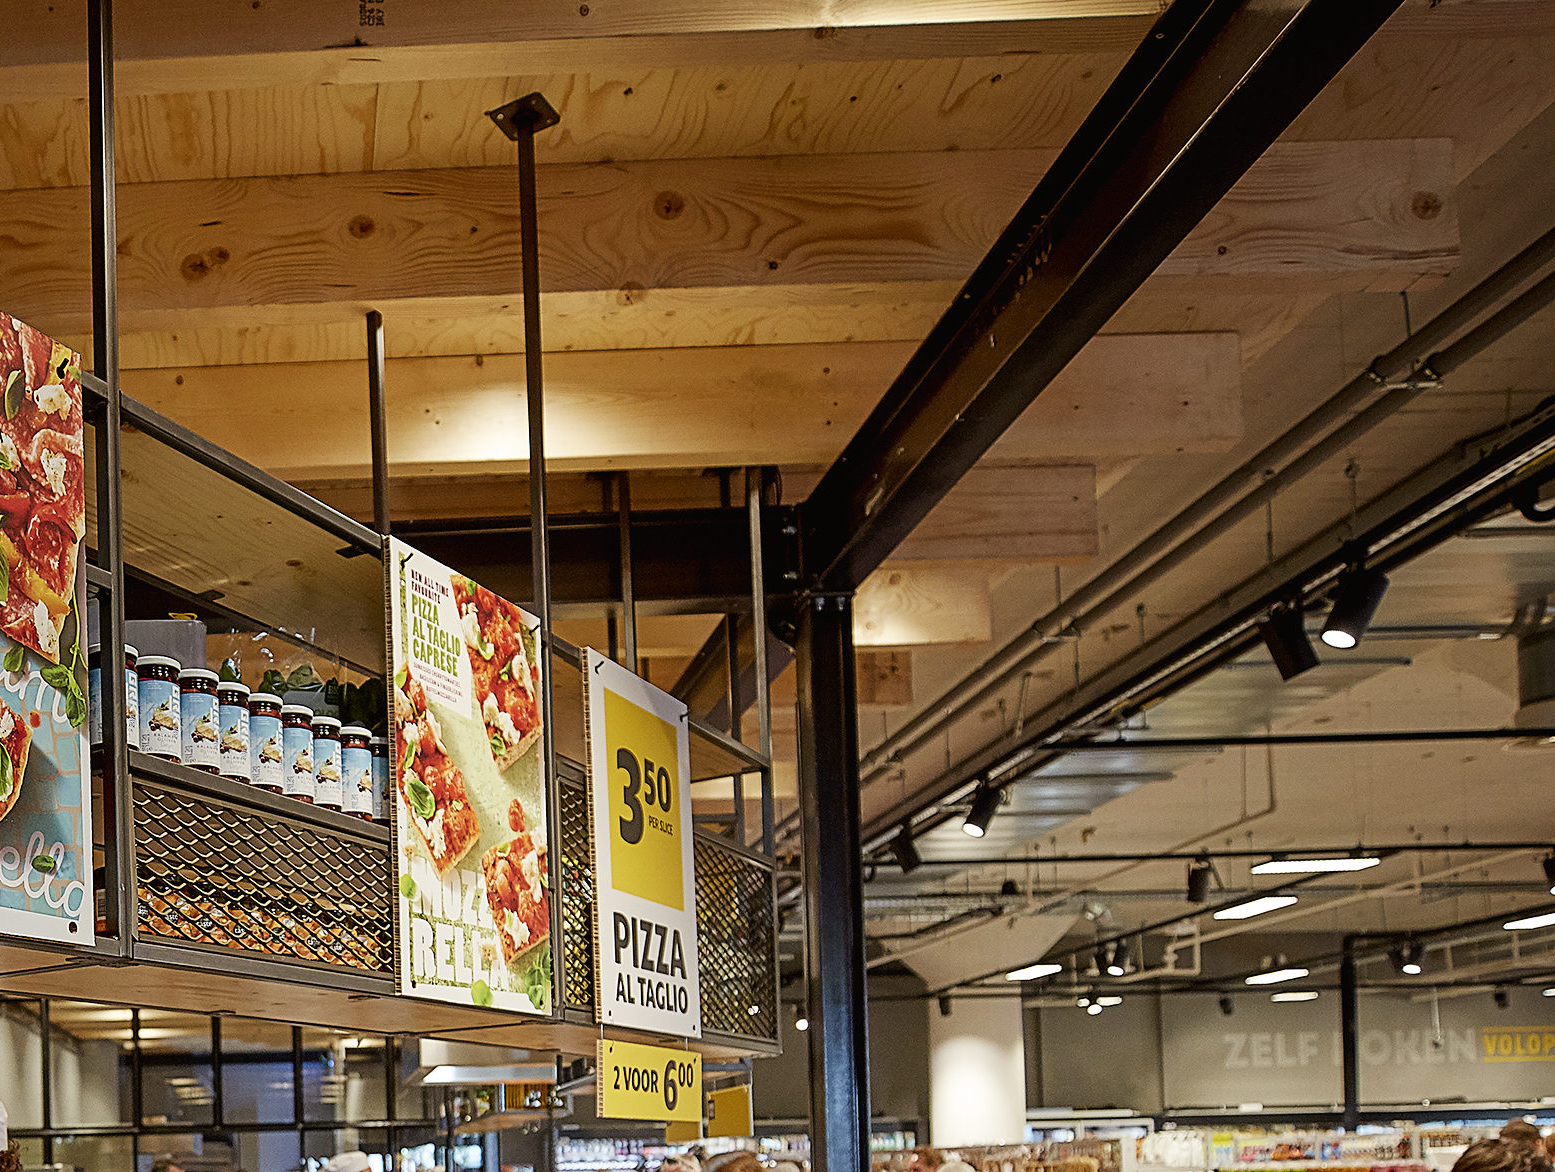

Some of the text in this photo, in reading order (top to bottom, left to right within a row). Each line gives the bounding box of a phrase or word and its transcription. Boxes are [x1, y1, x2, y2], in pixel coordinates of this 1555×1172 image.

[424, 576, 434, 589] ALL
[436, 582, 449, 597] TIME
[412, 593, 440, 626] PIZZA
[413, 615, 461, 657] AL TAGLIO
[413, 637, 458, 677] CAPRESE
[648, 815, 673, 836] PER SLICE
[613, 911, 687, 980] PIZZA
[616, 972, 688, 1014] AL TAGLIO
[1223, 1032, 1319, 1069] ZELF
[1333, 1027, 1477, 1067] OKEN
[613, 1066, 620, 1090] 2
[623, 1066, 659, 1093] VOOR
